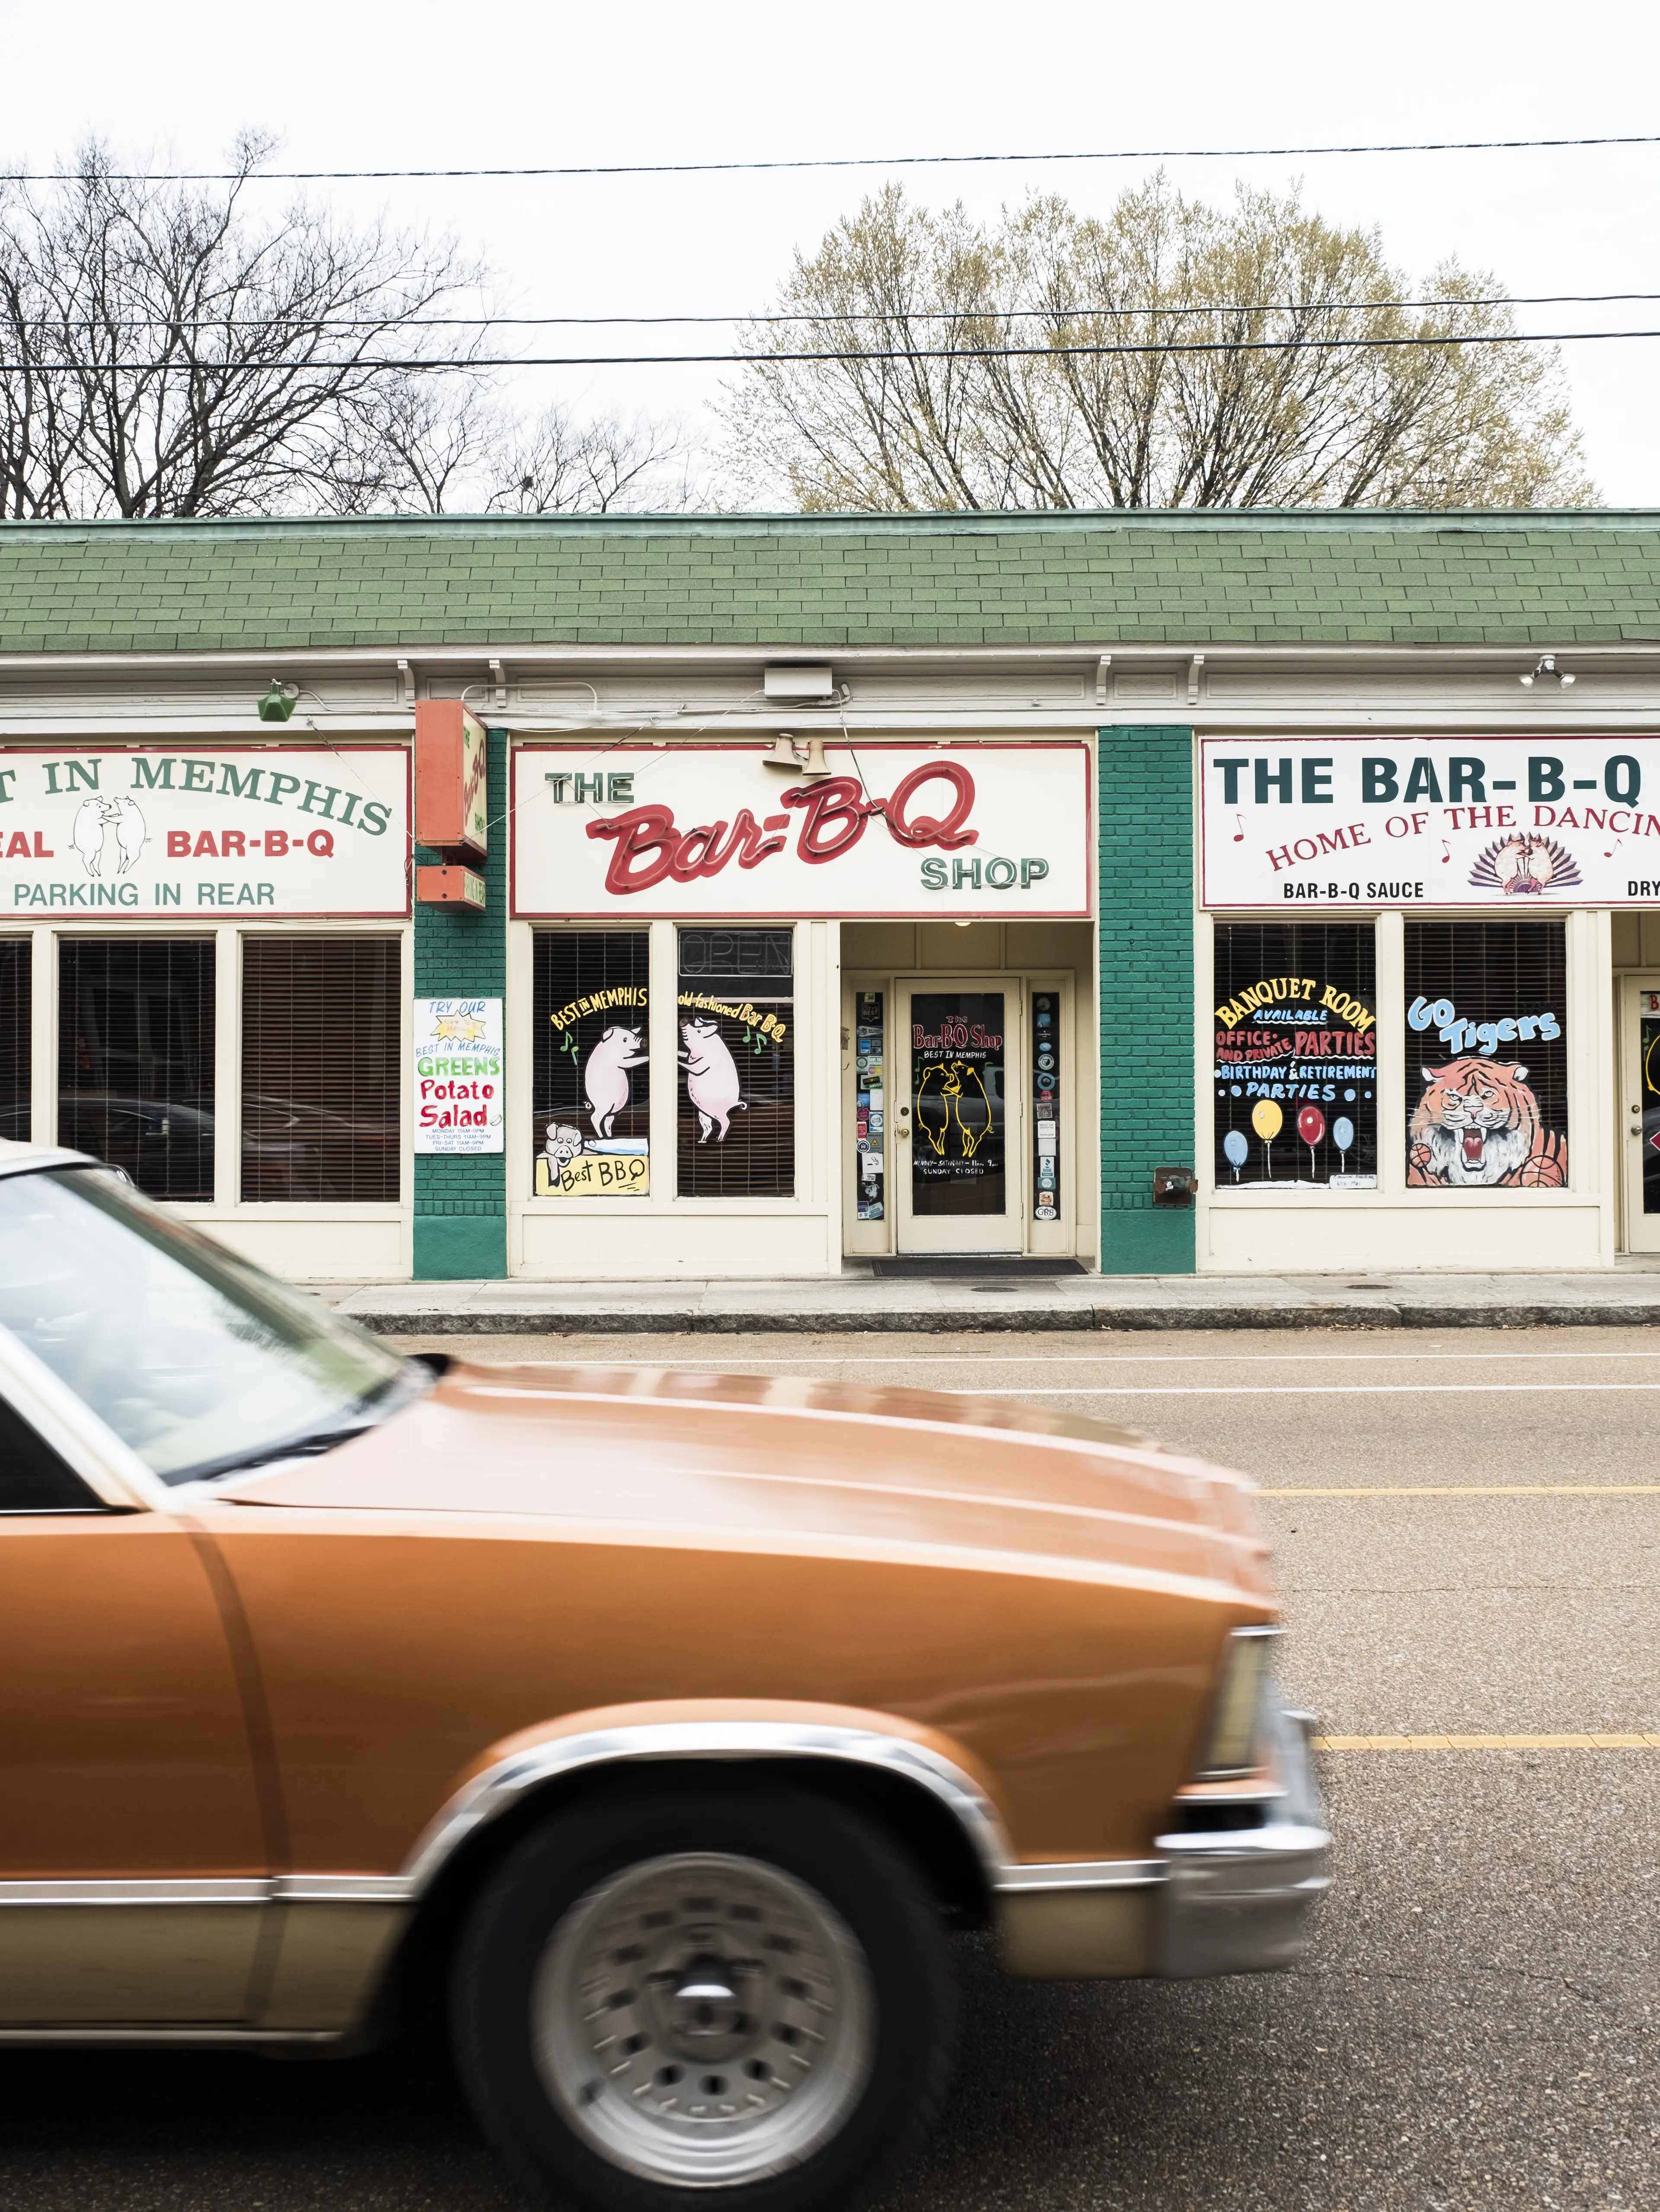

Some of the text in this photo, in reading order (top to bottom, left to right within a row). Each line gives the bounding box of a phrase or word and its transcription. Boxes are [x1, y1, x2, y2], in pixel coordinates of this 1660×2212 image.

[545, 773, 634, 804] THE
[1213, 755, 1641, 808] THE BAR-B-Q
[42, 759, 102, 794] IN
[131, 758, 392, 836] MEMPHIS
[168, 829, 335, 858] BAR-B-Q
[1266, 823, 1371, 871] HOME
[1385, 812, 1429, 838] OF
[1444, 806, 1516, 829] THE
[921, 857, 1049, 890] SHOP
[14, 883, 275, 906] PARKING IN REAR
[1284, 883, 1359, 900] BAR-B-Q
[1367, 882, 1423, 898] SAUCE
[429, 1001, 485, 1013] TRY OUR
[551, 987, 647, 1030] BEST IN MEMPHIS
[678, 991, 693, 1007] old
[695, 993, 743, 1018] fashioned
[739, 1004, 763, 1026] Bar
[1214, 978, 1376, 1033] BANQUET ROOM
[1254, 1010, 1328, 1020] AVAILABLE
[970, 1024, 1002, 1050] Shop
[1216, 1031, 1375, 1055] OFFICE PARTIES
[1440, 1012, 1561, 1055] Tigers
[416, 1042, 500, 1057] BEST IN MEMPHIS
[945, 1050, 953, 1058] IN
[1216, 1038, 1292, 1061] AND PRIVATE
[418, 1057, 500, 1077] GREENS
[1221, 1065, 1287, 1079] BIRTHDAY
[1299, 1065, 1376, 1079] RETIREMENT
[421, 1079, 494, 1100] Potato
[1246, 1082, 1335, 1101] PARTIES
[419, 1104, 487, 1128] Salad
[561, 1159, 645, 1192] Best BBQ
